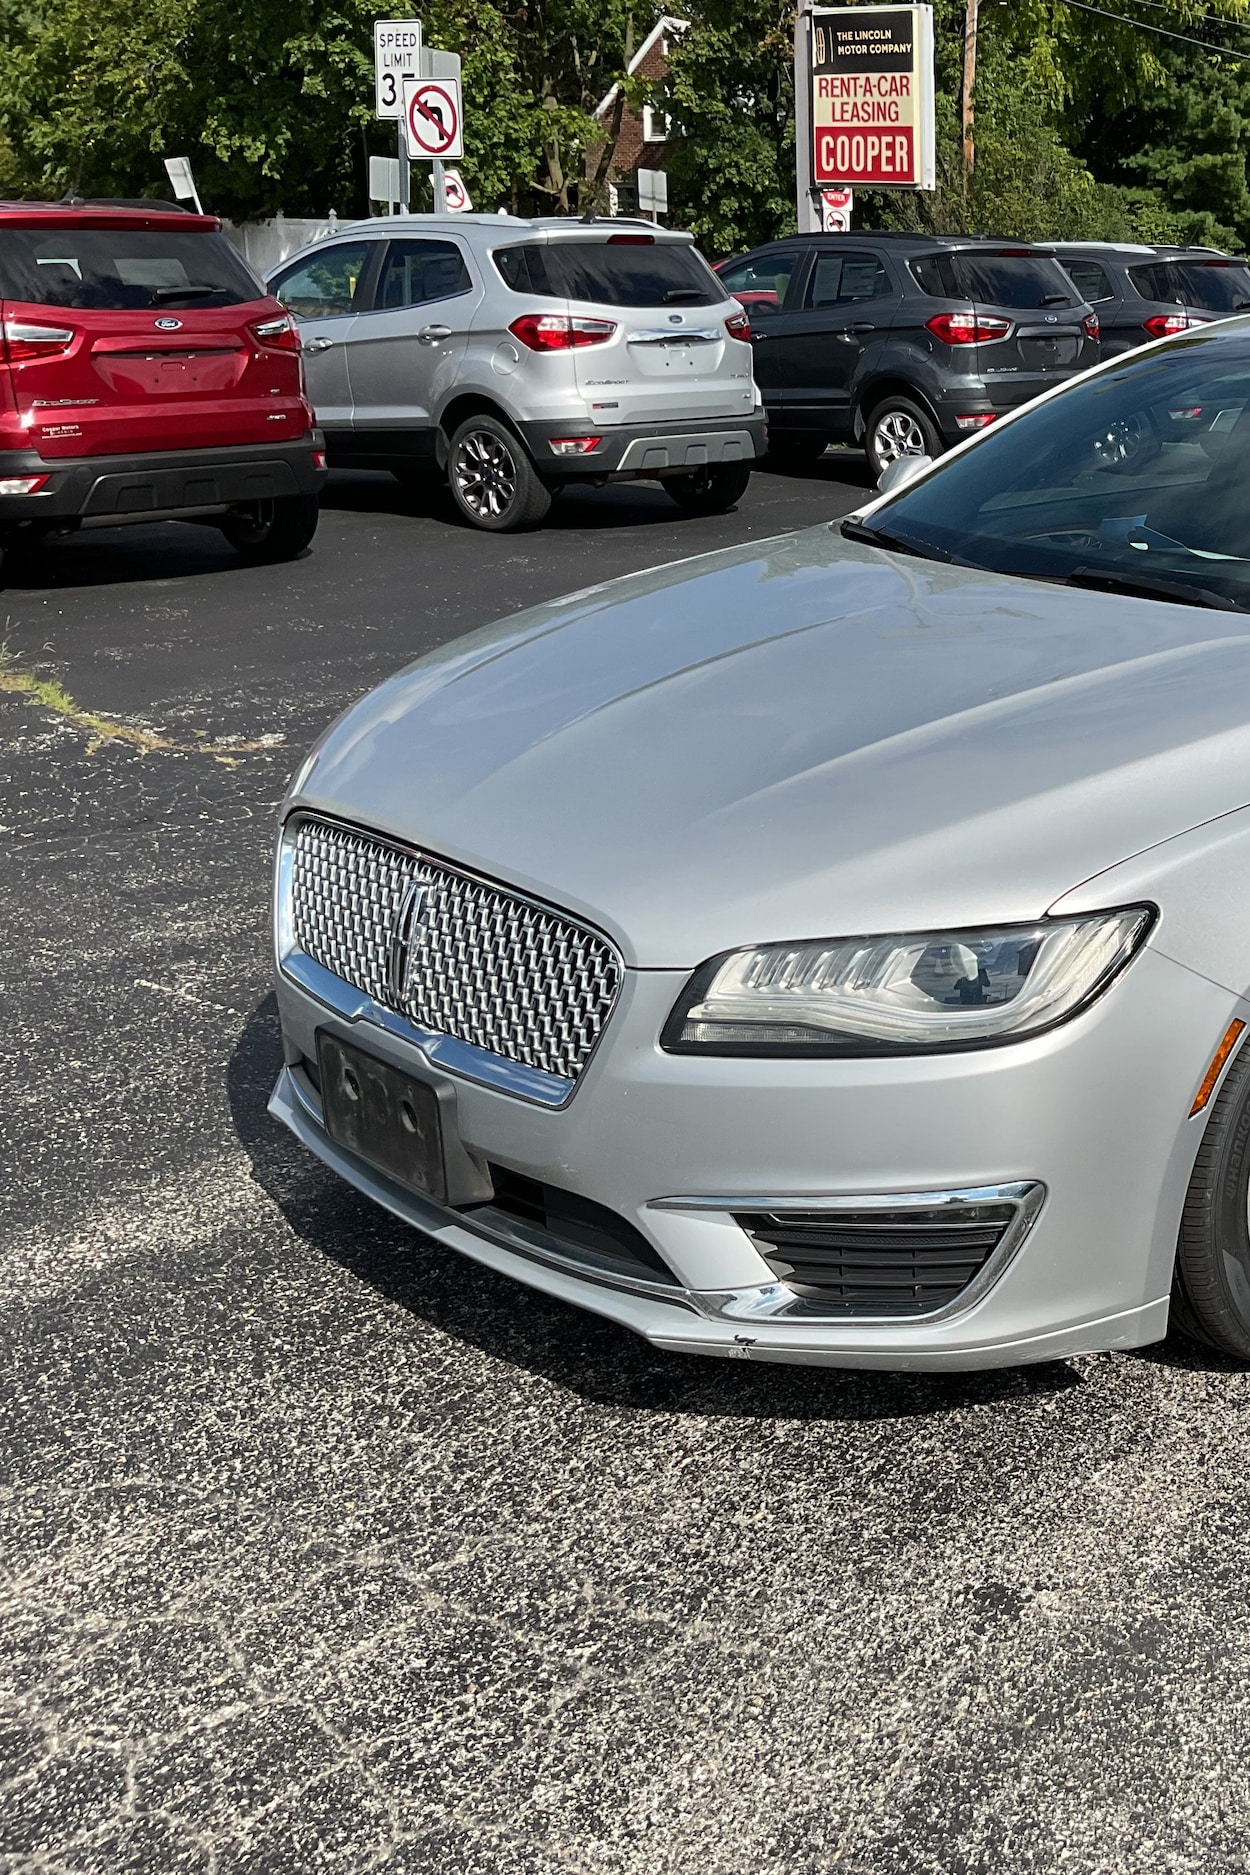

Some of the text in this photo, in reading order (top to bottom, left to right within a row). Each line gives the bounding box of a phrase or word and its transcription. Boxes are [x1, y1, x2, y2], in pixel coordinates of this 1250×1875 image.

[379, 33, 417, 47] SPEED
[837, 29, 892, 41] THE LINCOLN
[838, 43, 912, 55] MOTOR COMPANY
[383, 53, 413, 67] LIMIT
[818, 75, 911, 98] RENT-A-CAR
[831, 101, 899, 122] LEASING
[821, 135, 909, 172] COOPER
[827, 192, 846, 202] ENTER
